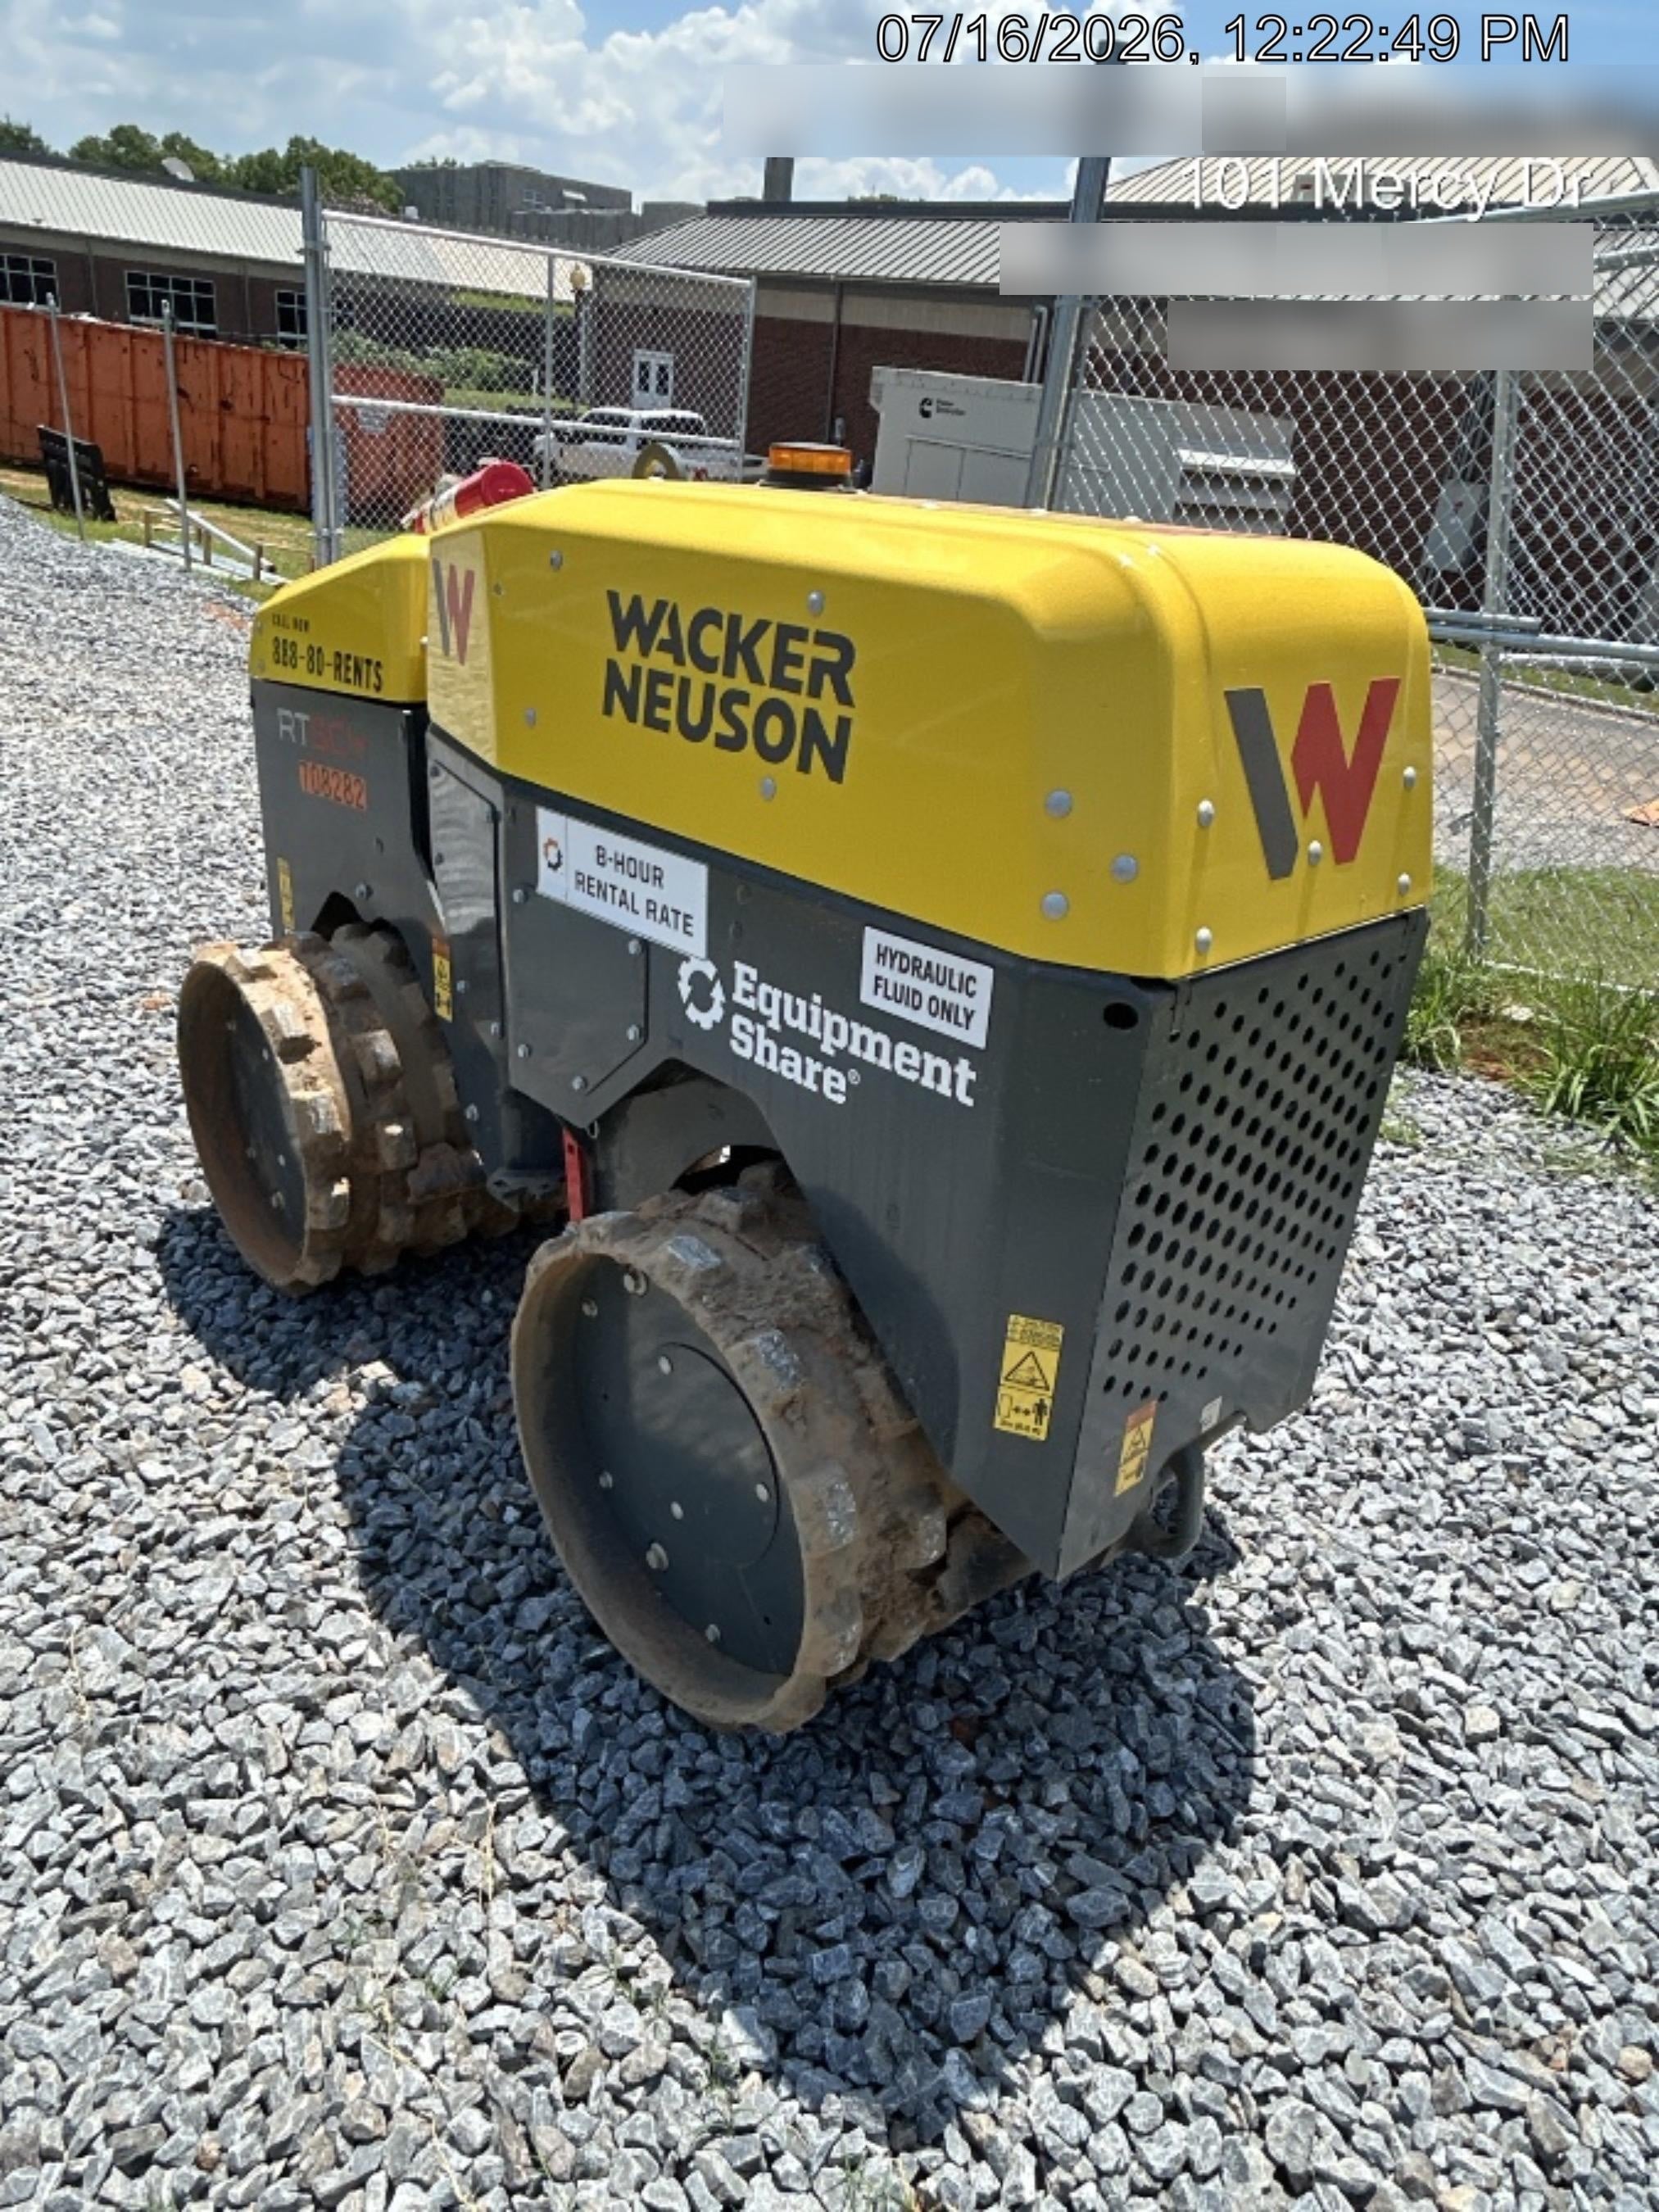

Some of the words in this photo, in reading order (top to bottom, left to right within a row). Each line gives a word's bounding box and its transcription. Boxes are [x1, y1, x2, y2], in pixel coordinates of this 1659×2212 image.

[605, 589, 856, 708] WACKER
[601, 659, 853, 785] NEUSON
[574, 869, 640, 915] RENTAL
[646, 898, 695, 937] RATE
[873, 975, 923, 1011] FLUID
[927, 995, 977, 1031] ONLY
[876, 943, 977, 999] HYDRAULIC
[732, 960, 977, 1108] Equipment
